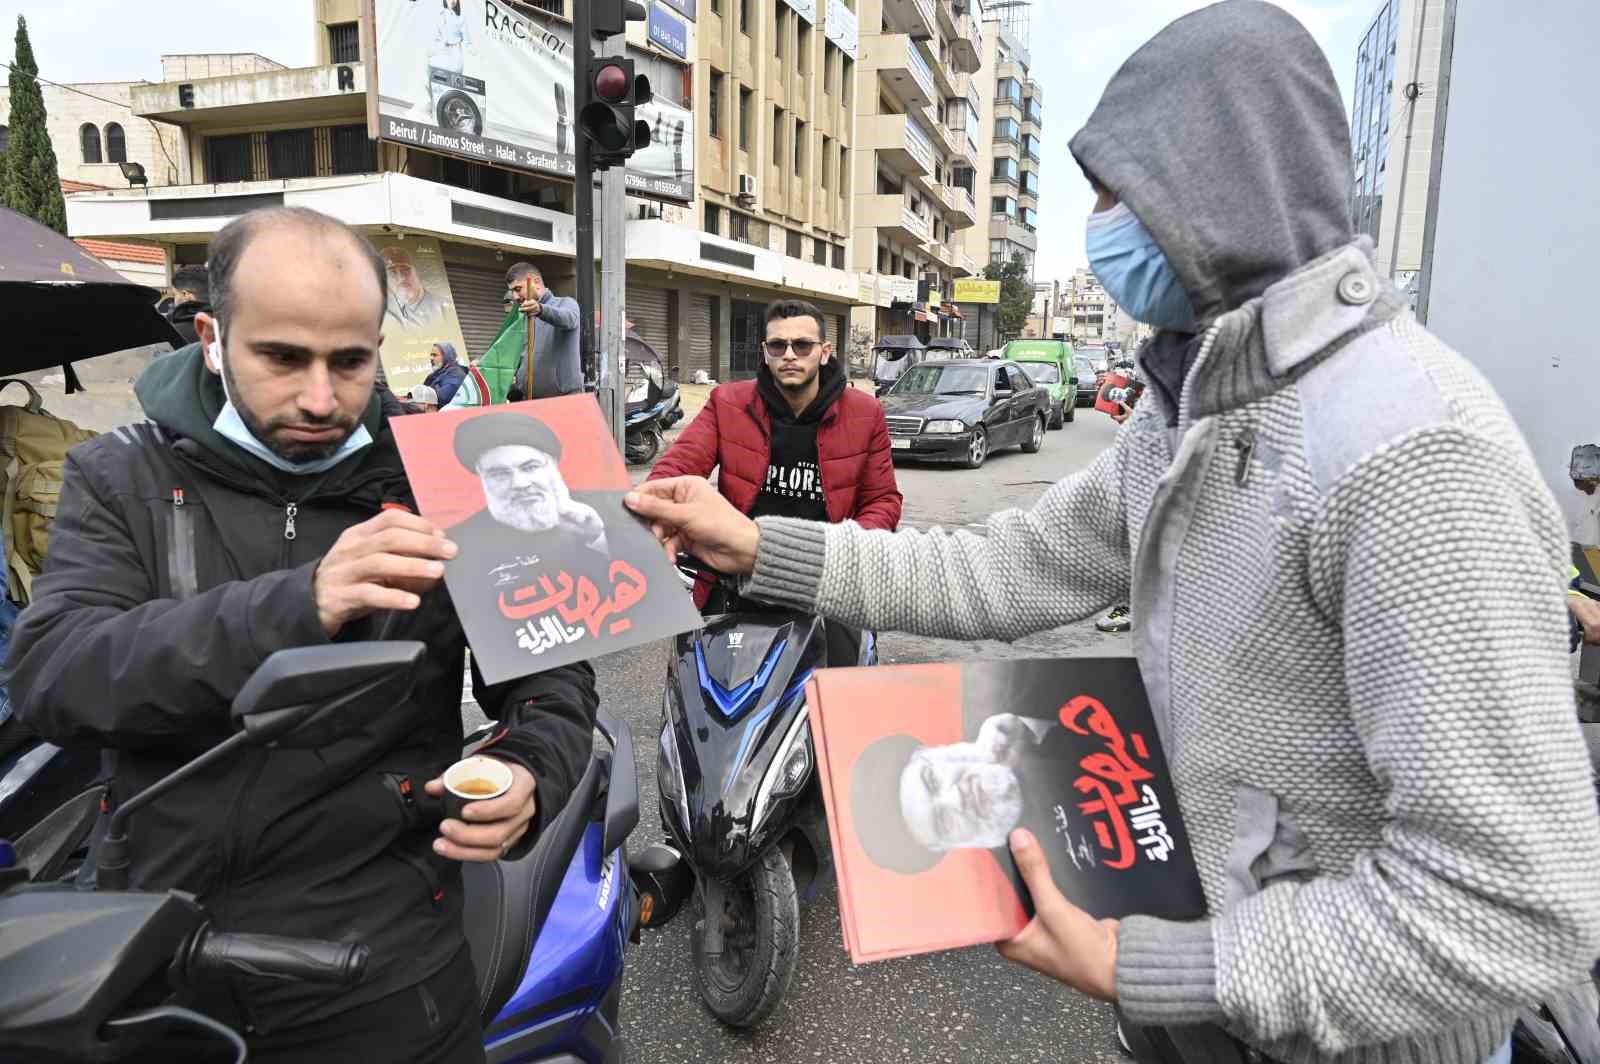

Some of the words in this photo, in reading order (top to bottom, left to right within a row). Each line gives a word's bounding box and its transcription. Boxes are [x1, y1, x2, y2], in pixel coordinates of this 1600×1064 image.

[178, 84, 195, 109] E
[337, 66, 354, 91] R
[389, 121, 418, 141] Beirut
[426, 131, 460, 149] Jamous
[460, 137, 486, 155] Street
[496, 145, 516, 161] Halat
[497, 559, 648, 640] هيهات
[1058, 694, 1155, 870] هيهات
